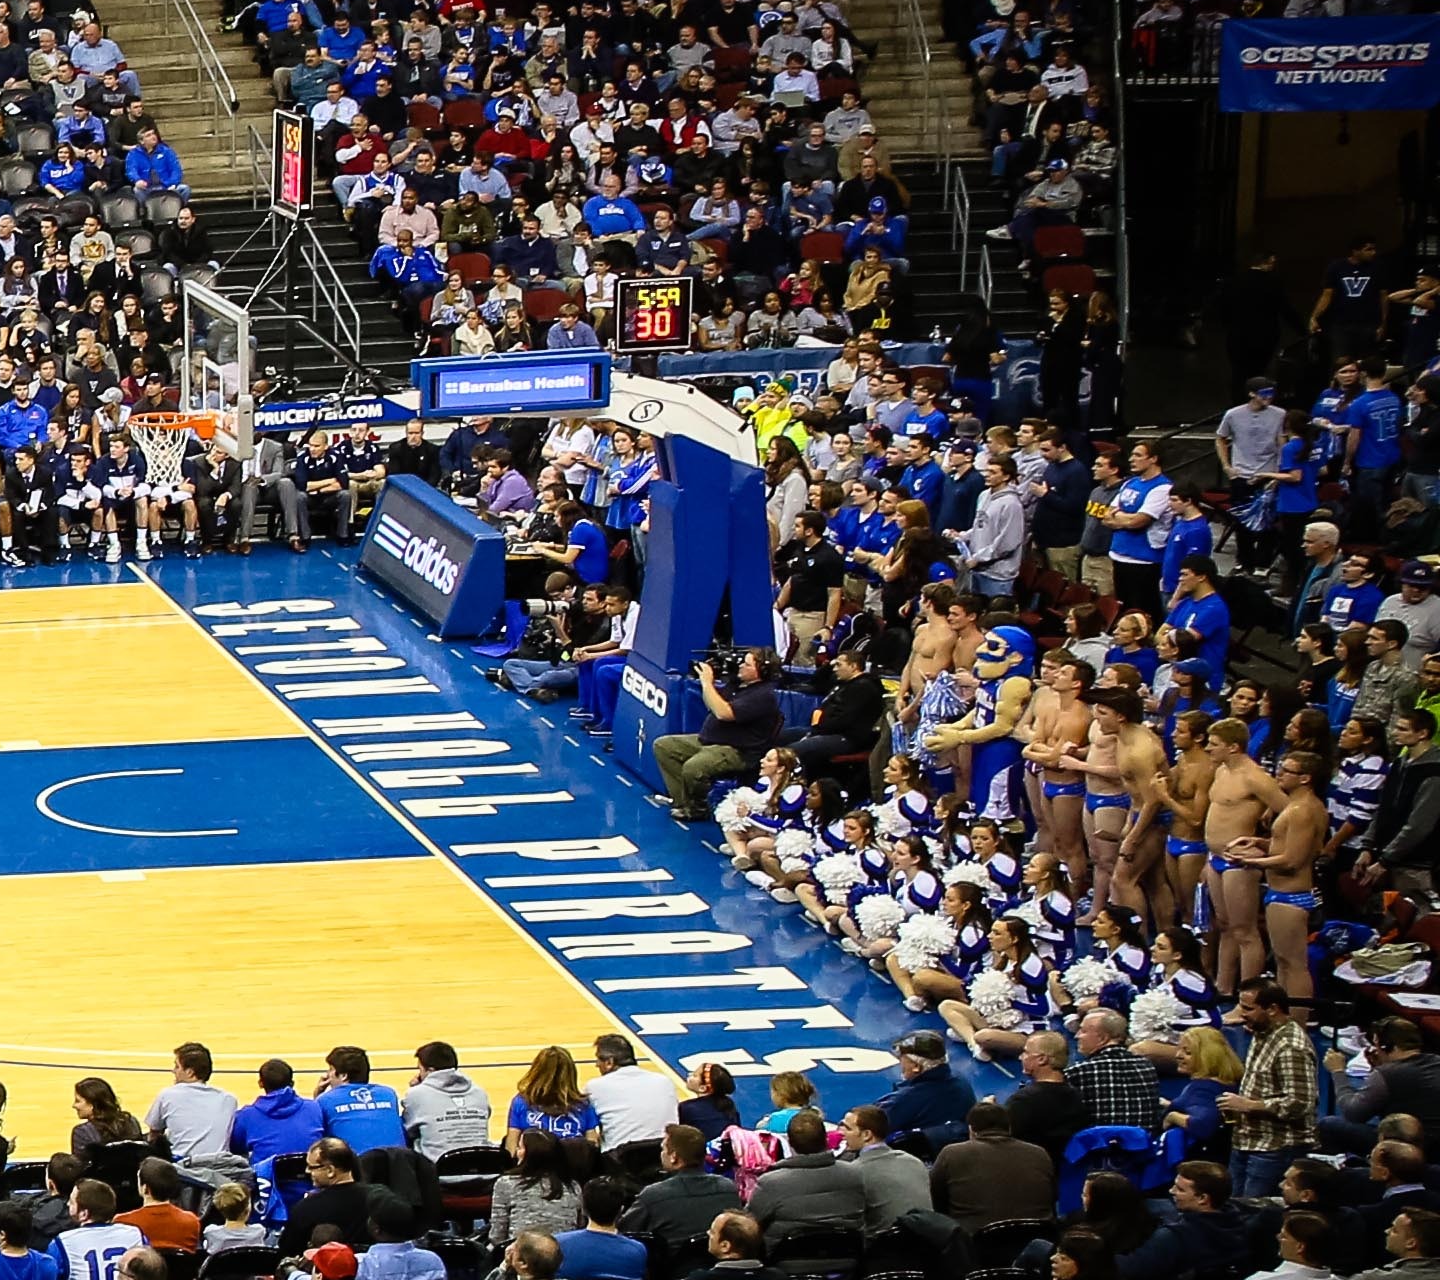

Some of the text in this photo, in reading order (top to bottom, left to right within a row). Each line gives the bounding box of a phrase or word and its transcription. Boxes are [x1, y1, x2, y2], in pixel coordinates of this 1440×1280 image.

[1262, 42, 1431, 69] CBS SPORTS
[1275, 68, 1388, 85] NETWORK
[637, 287, 681, 309] 5:59
[637, 310, 671, 338] 30
[459, 375, 585, 394] Barnabas Health
[405, 534, 459, 596] adidas
[621, 664, 668, 718] GEICO
[192, 597, 900, 1076] SETON HALL PIRATES
